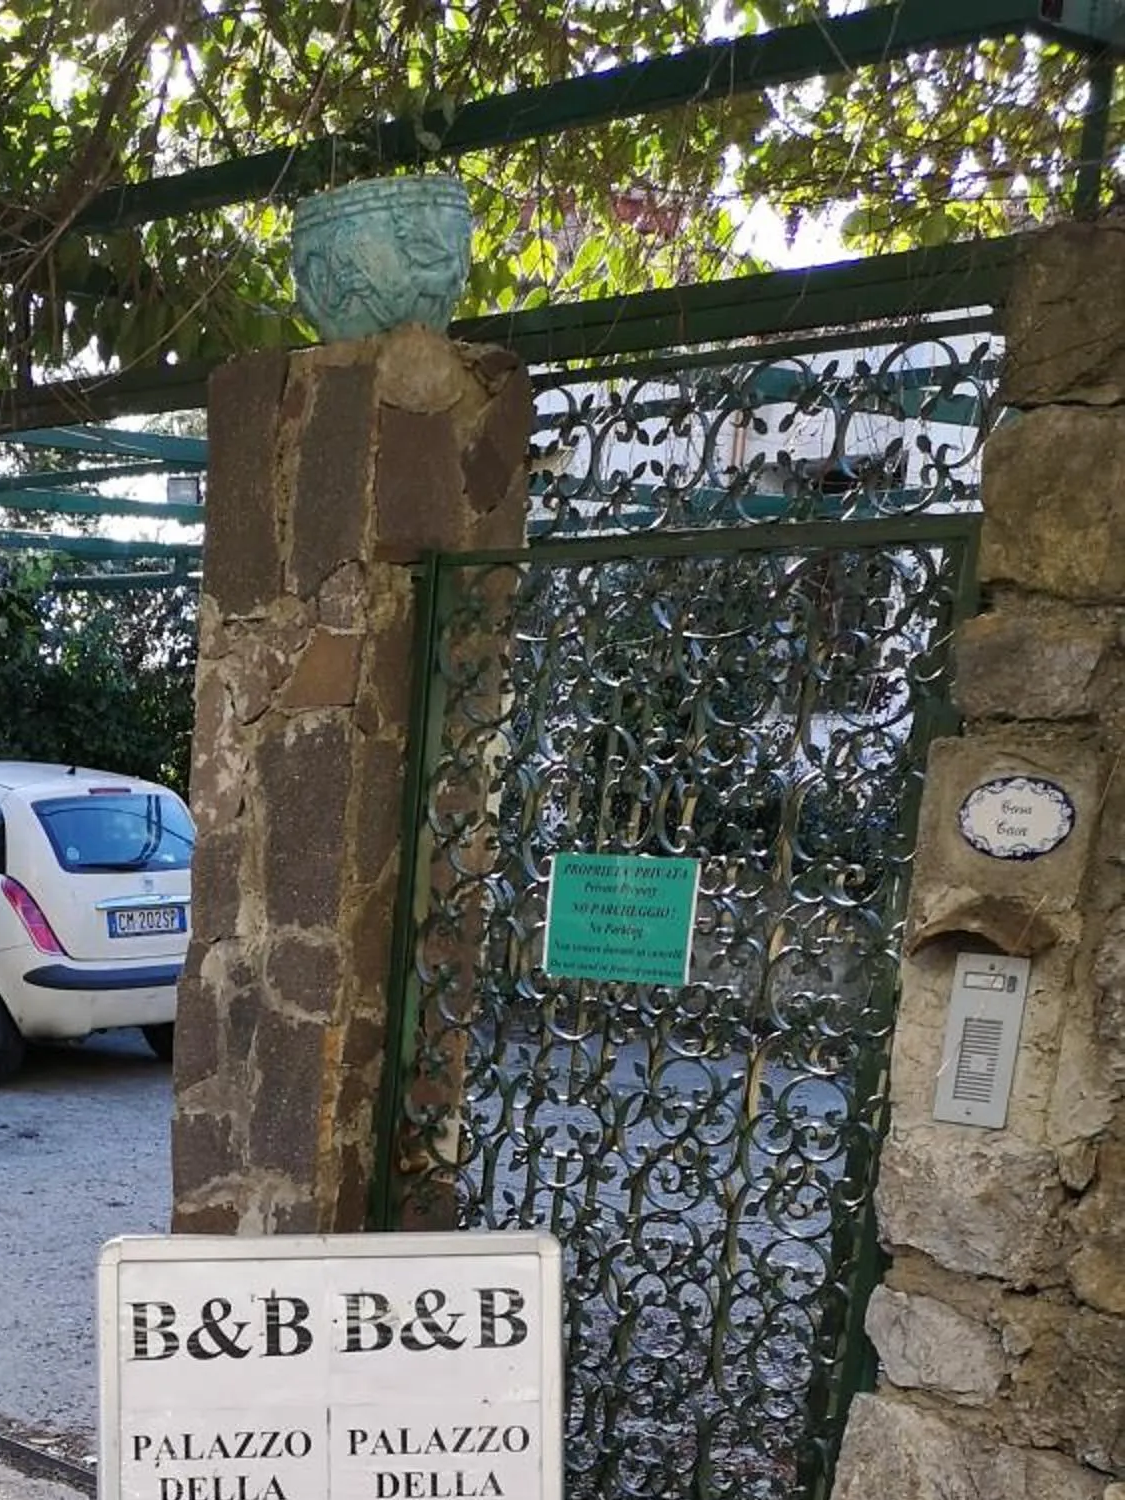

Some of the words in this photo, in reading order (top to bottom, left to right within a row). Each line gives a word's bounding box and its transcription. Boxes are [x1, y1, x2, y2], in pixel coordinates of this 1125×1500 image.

[126, 1295, 314, 1361] B&B
[340, 1288, 528, 1353] B&B
[133, 1430, 312, 1461] PALAZZO
[347, 1425, 530, 1456] PALAZZO
[375, 1471, 505, 1499] DELLA
